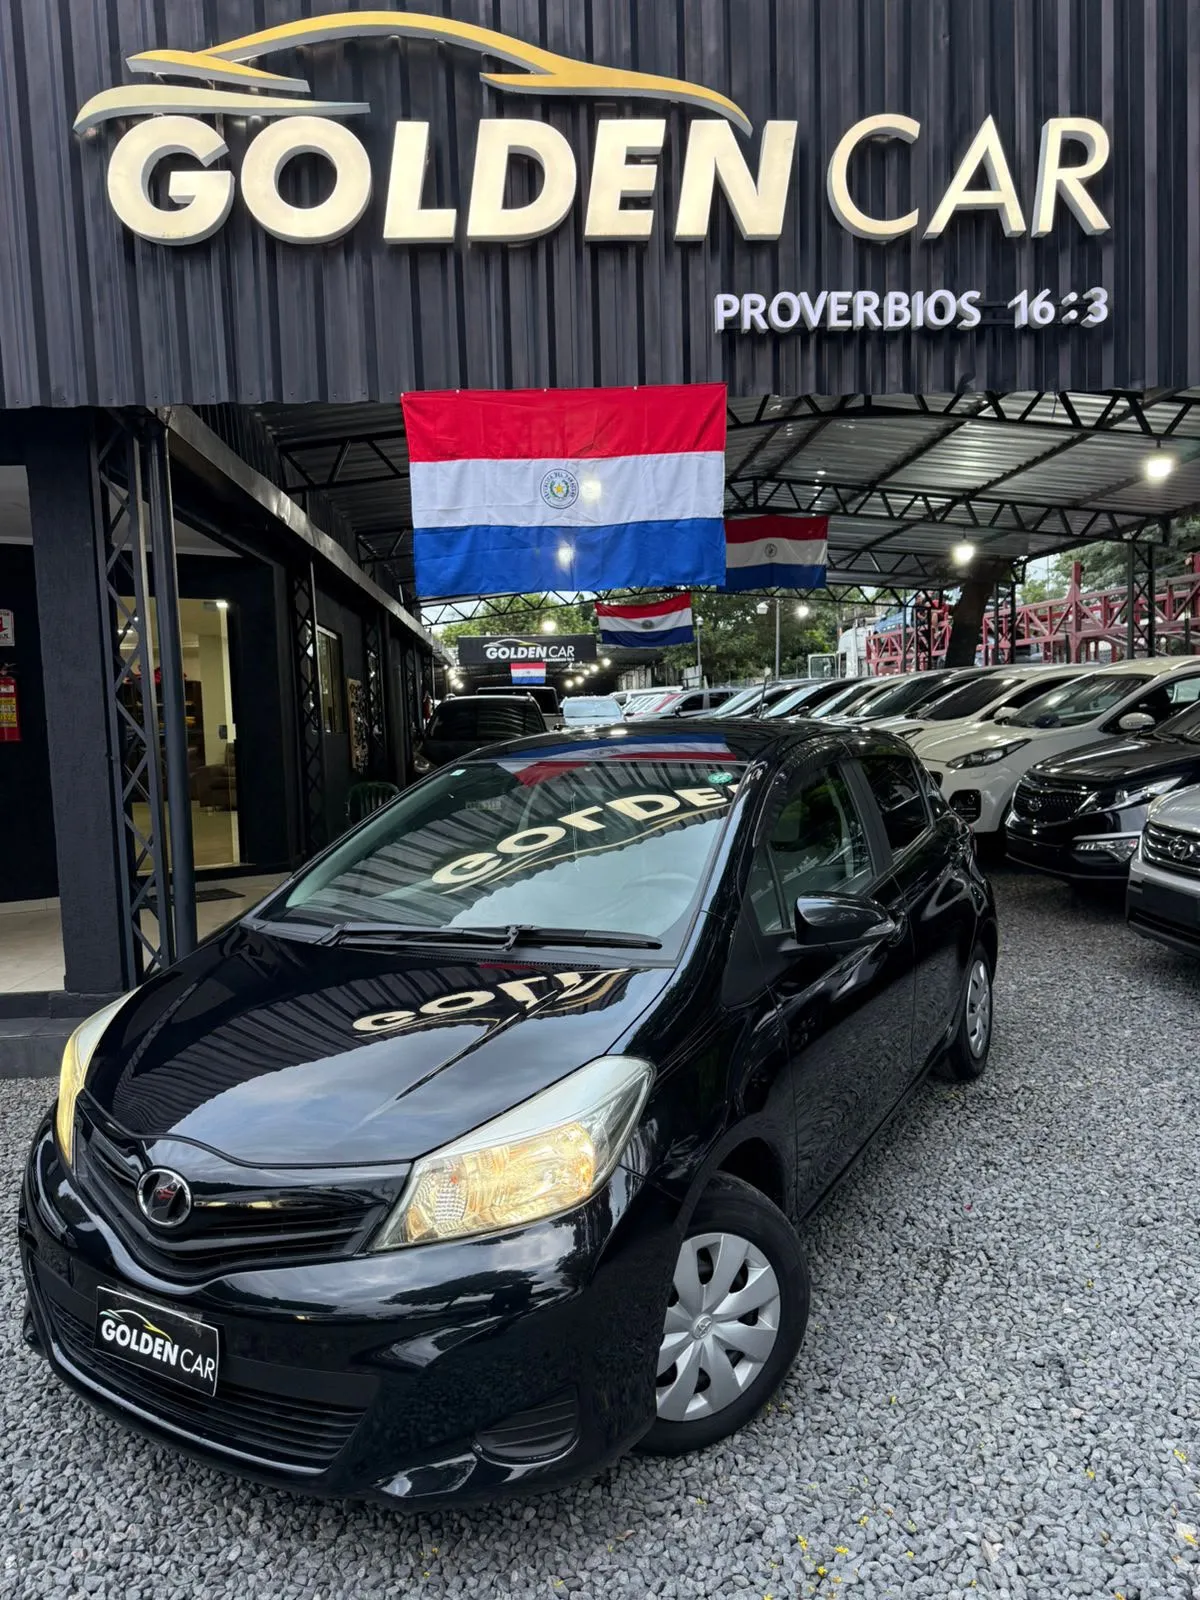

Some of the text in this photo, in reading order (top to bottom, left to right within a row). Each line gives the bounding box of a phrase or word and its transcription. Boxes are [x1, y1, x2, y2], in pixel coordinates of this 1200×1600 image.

[107, 114, 1111, 244] GOLDEN CAR
[714, 287, 1110, 333] PROVERBIOS 16:3
[486, 646, 547, 660] GOLDEN
[548, 645, 575, 658] CAR
[101, 1318, 216, 1382] GOLDEN CAR
